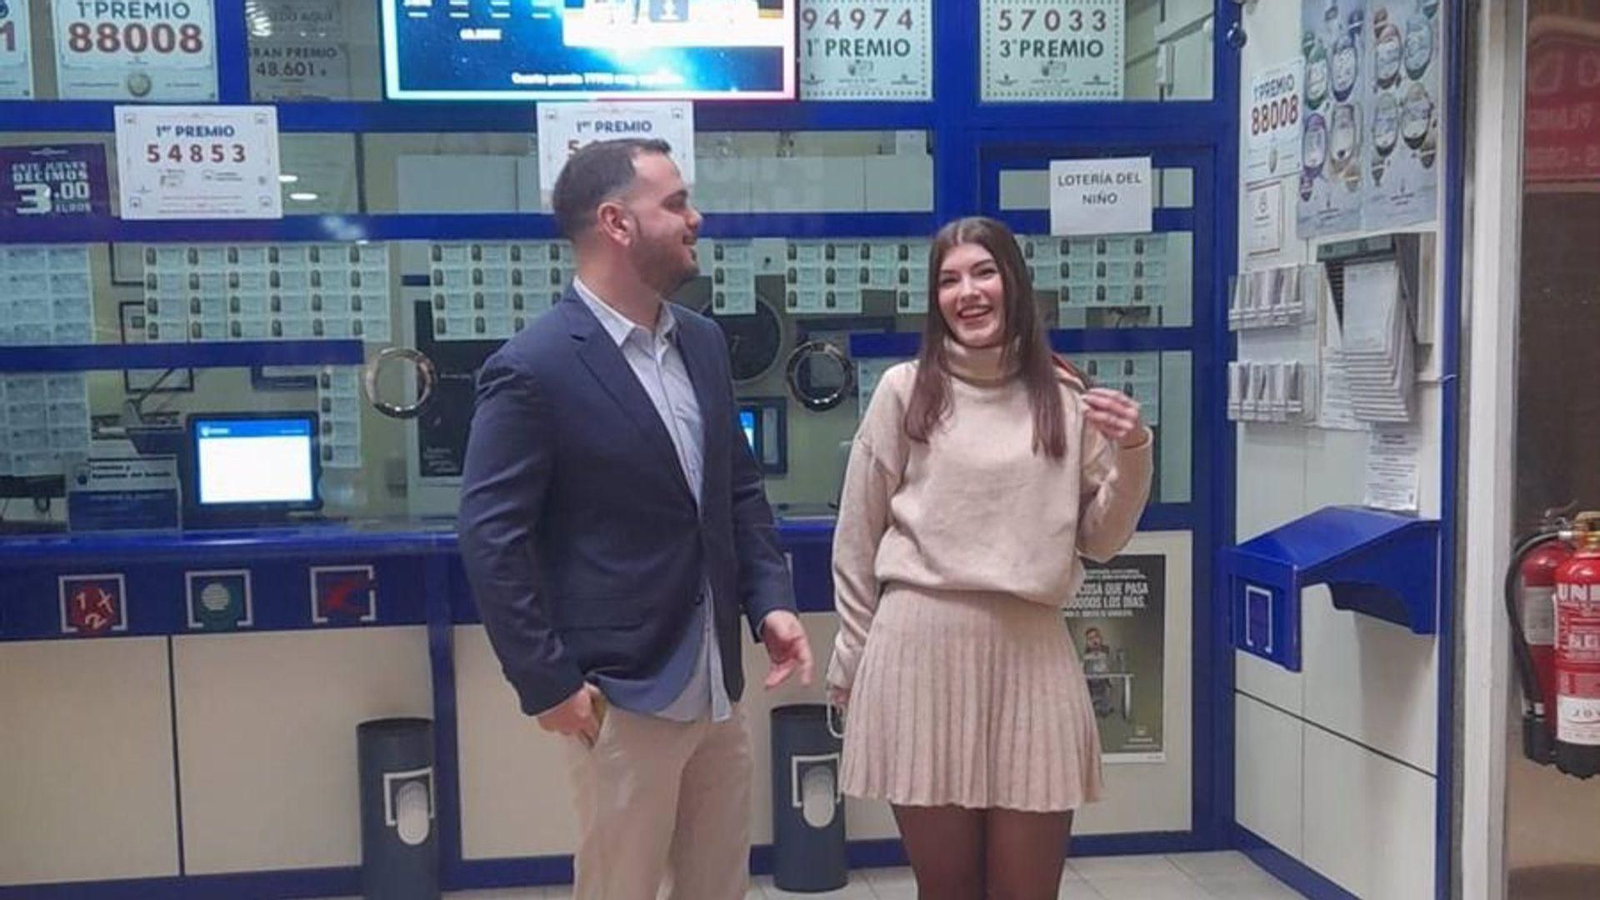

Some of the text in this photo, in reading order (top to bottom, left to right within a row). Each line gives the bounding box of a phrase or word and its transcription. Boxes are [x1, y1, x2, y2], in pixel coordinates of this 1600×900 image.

[95, 2, 190, 19] PREMIO
[802, 9, 912, 31] 94974
[998, 9, 1106, 32] 57033
[68, 22, 203, 53] 88008
[825, 39, 911, 58] PREMIO
[1019, 40, 1104, 58] PREMIO
[1251, 94, 1298, 136] 88008
[175, 125, 235, 138] PREMIO
[595, 120, 652, 133] PREMIO
[147, 144, 246, 163] 54853
[1058, 170, 1141, 187] LOTERÍA DEL
[1082, 190, 1118, 205] NIÑO
[1125, 582, 1148, 595] PASA
